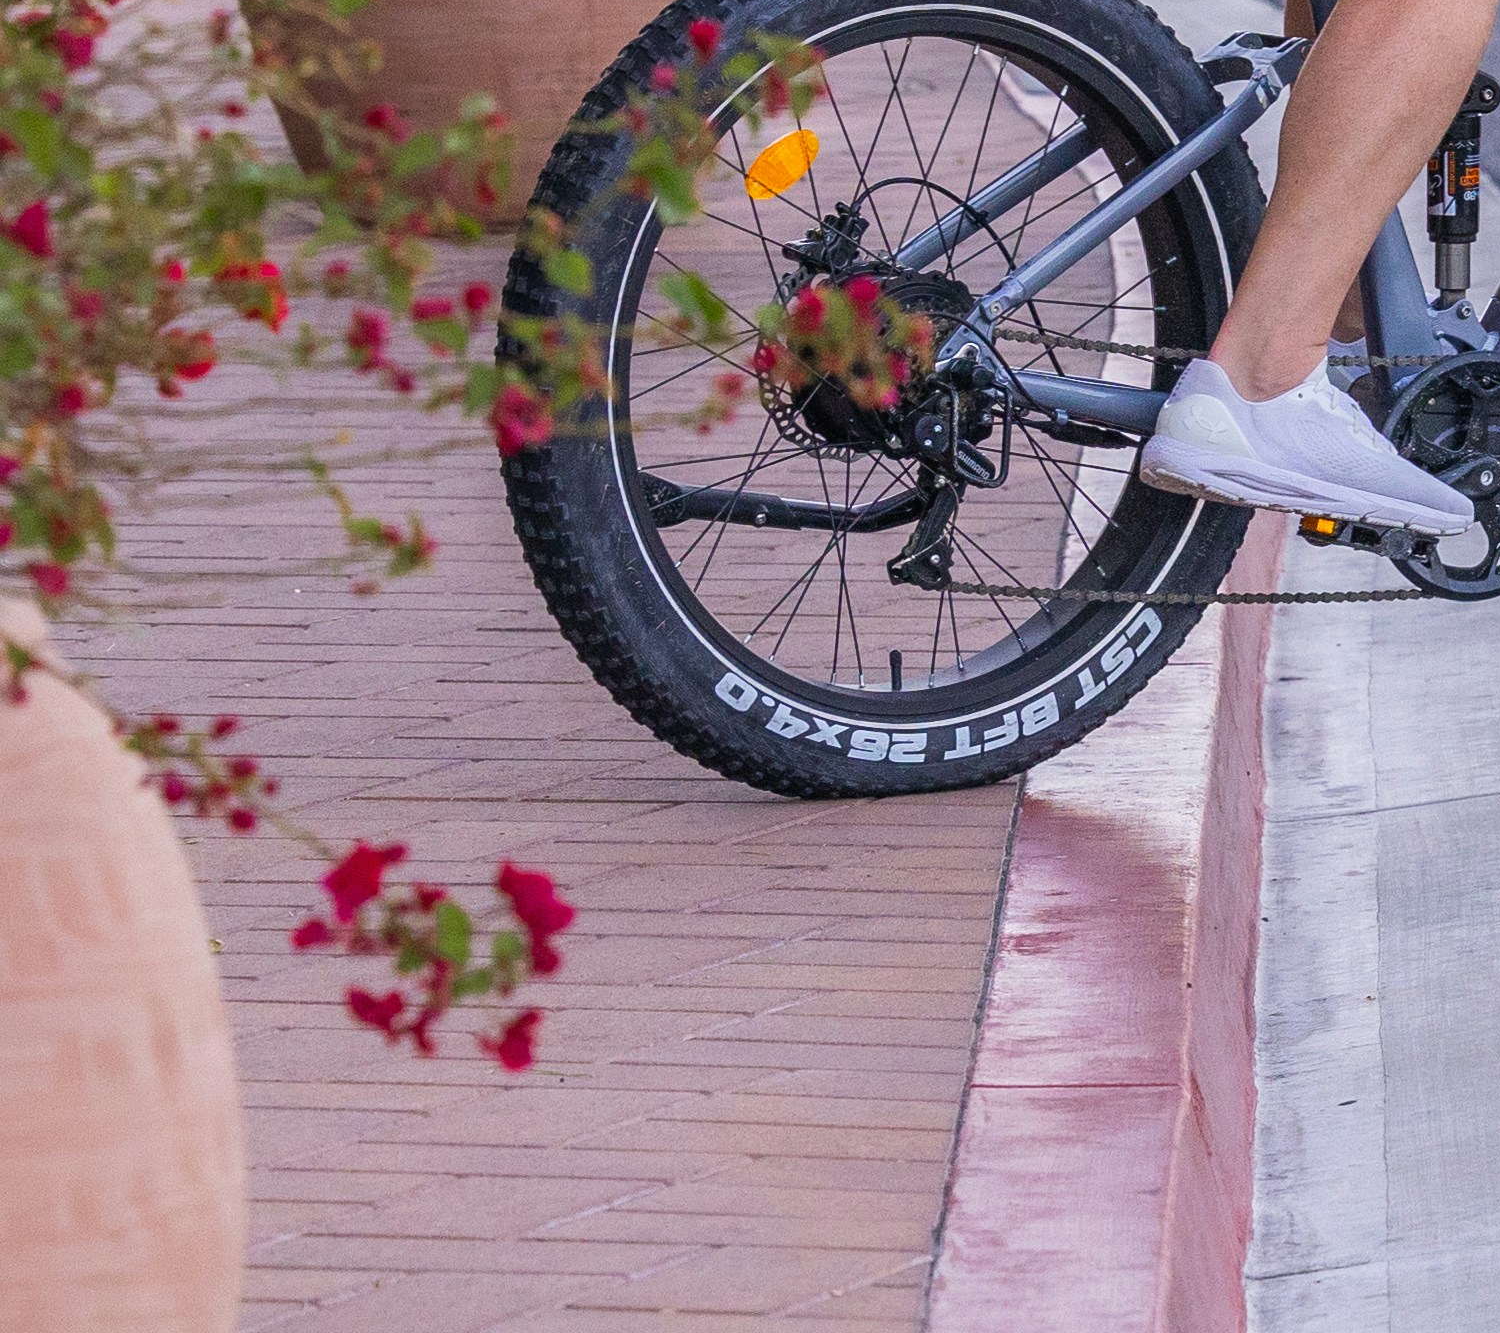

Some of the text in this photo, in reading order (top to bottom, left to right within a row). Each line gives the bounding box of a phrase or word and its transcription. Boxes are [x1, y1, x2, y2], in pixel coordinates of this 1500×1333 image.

[956, 450, 991, 480] SHIMANO
[714, 606, 1164, 763] CST BFT 26x4.0
